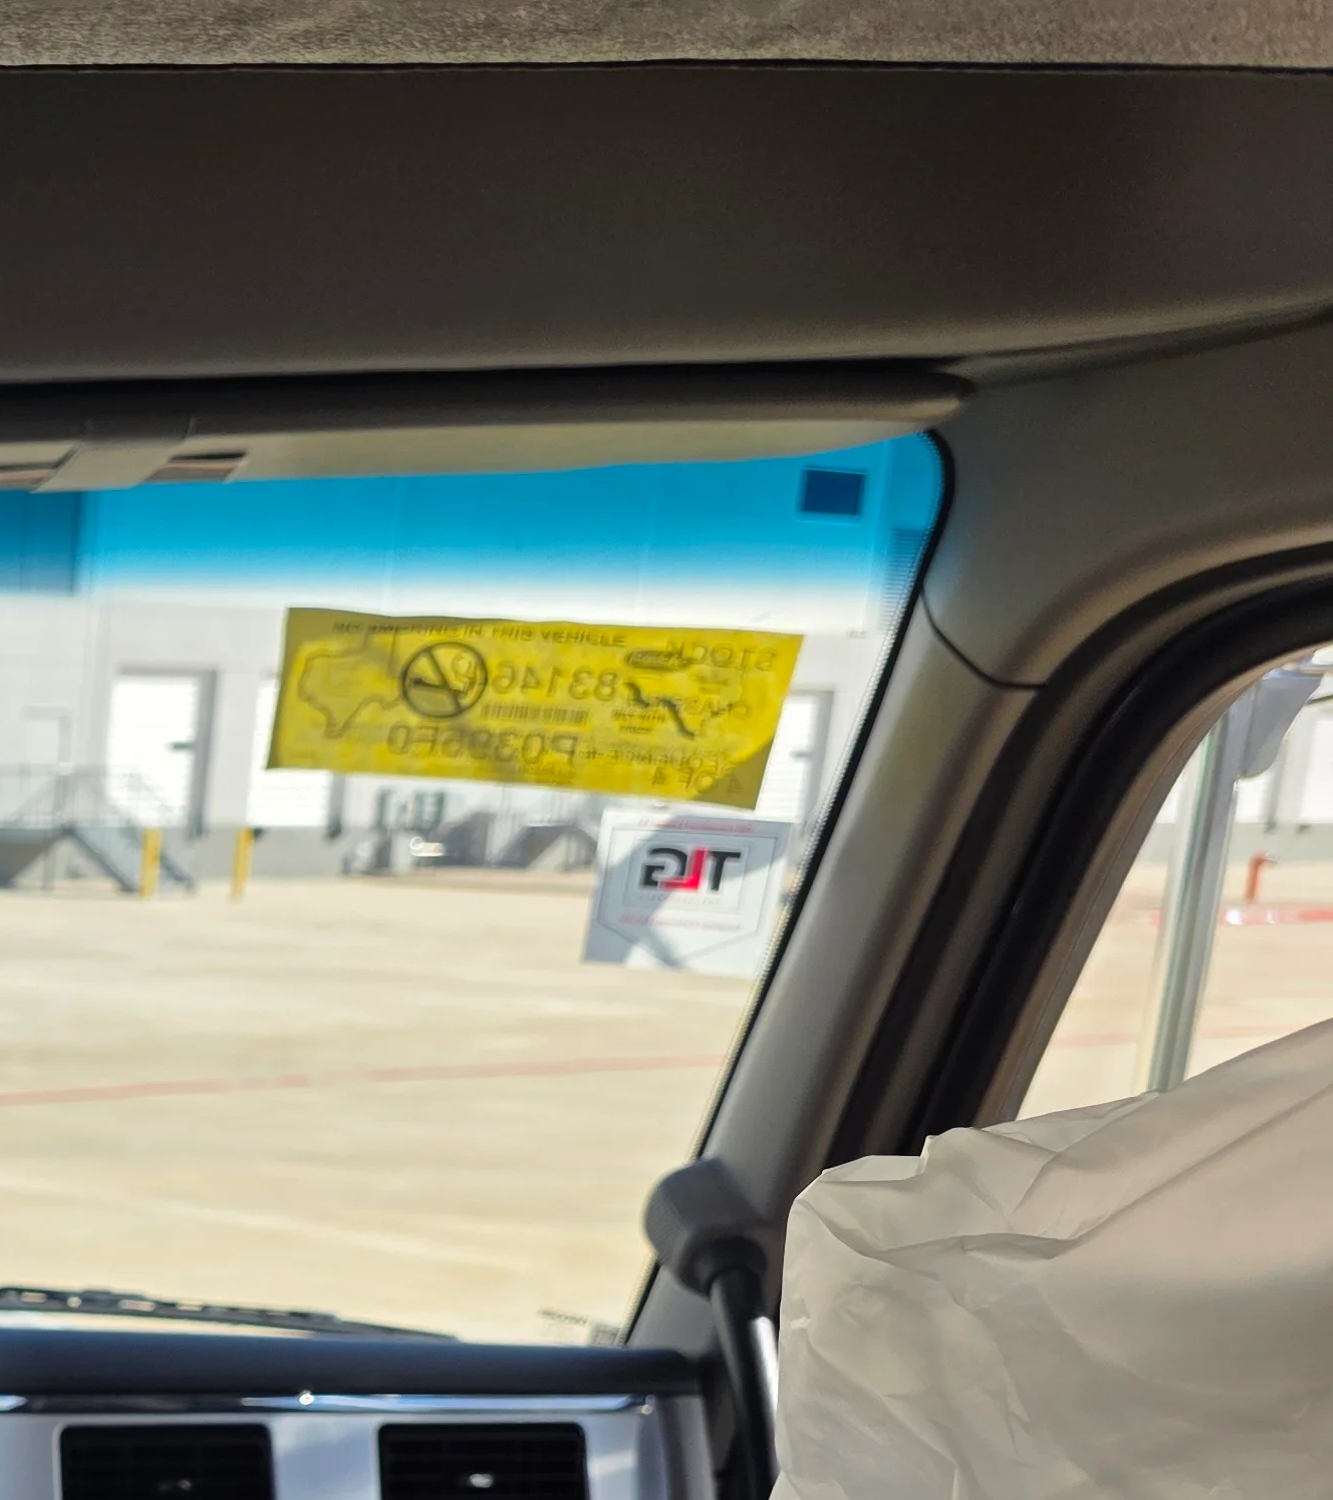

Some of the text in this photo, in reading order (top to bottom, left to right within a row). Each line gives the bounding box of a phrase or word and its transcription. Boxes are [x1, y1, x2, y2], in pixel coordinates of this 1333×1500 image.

[464, 624, 483, 638] IN
[491, 627, 534, 642] THIS
[542, 631, 626, 647] VEHICLE
